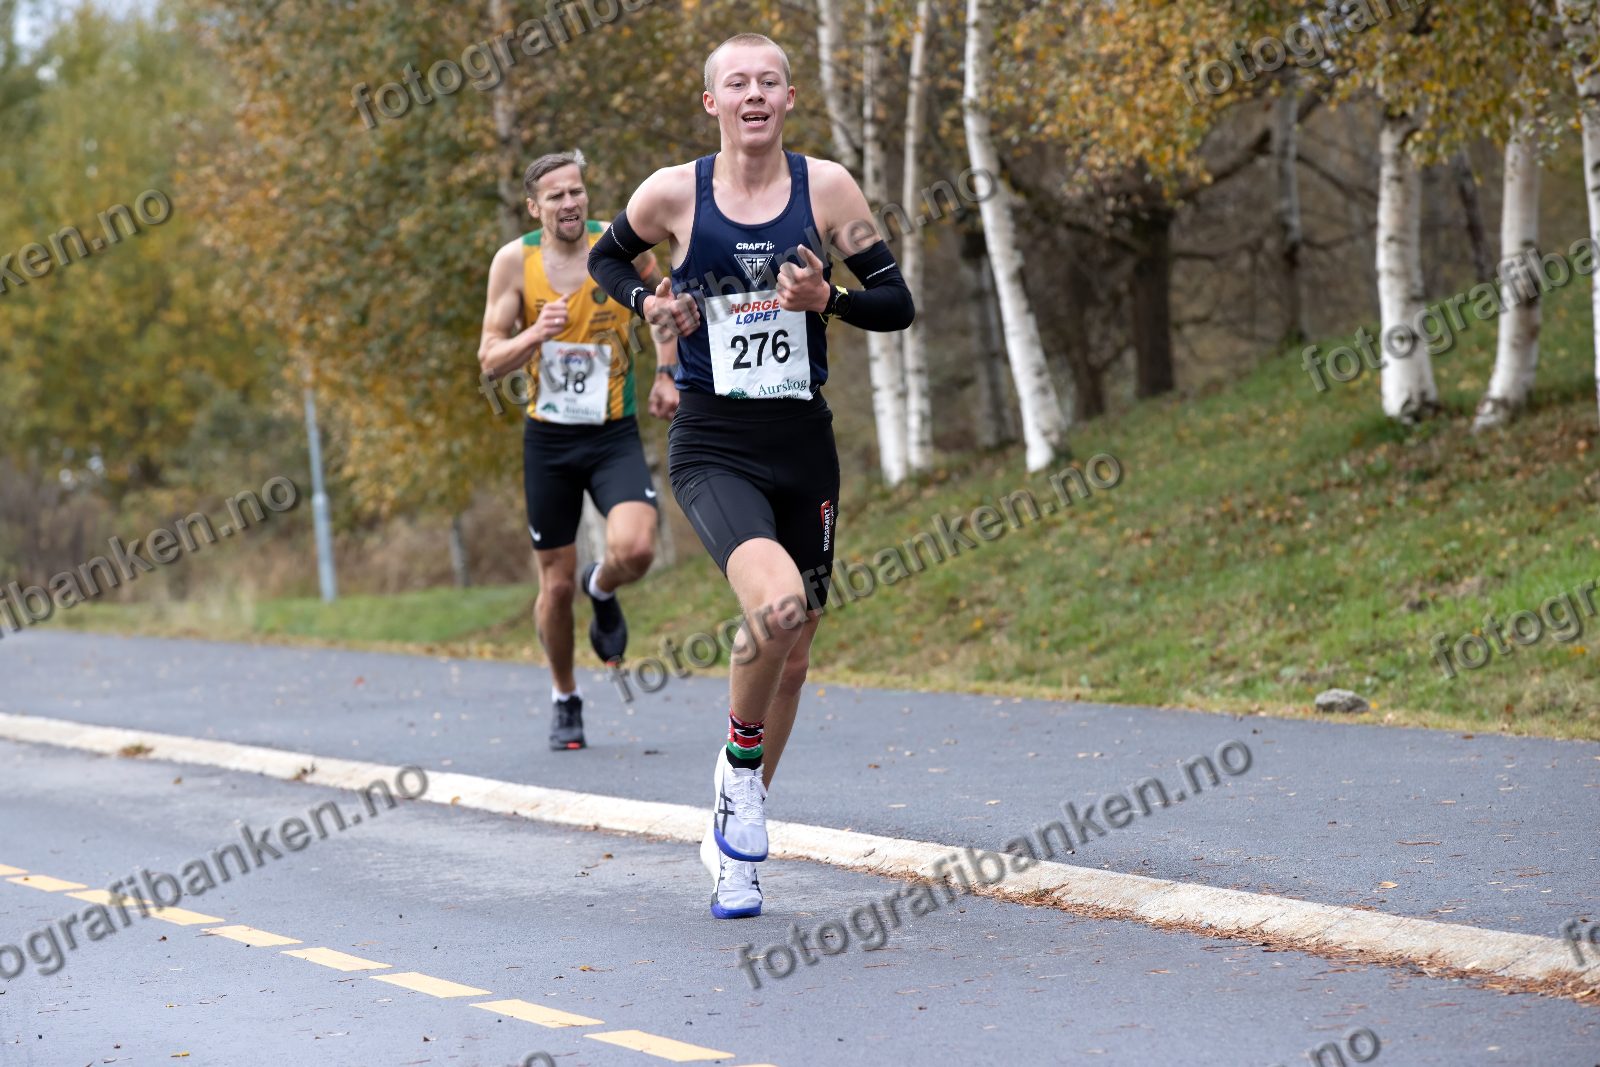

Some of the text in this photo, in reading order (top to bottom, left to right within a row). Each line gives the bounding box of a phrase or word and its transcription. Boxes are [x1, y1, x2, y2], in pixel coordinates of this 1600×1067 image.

[736, 242, 767, 251] CRAFT
[730, 298, 780, 314] NORGE
[735, 309, 781, 325] LØPET
[730, 329, 791, 370] 276
[562, 371, 586, 394] 18
[757, 378, 807, 397] Aurskog
